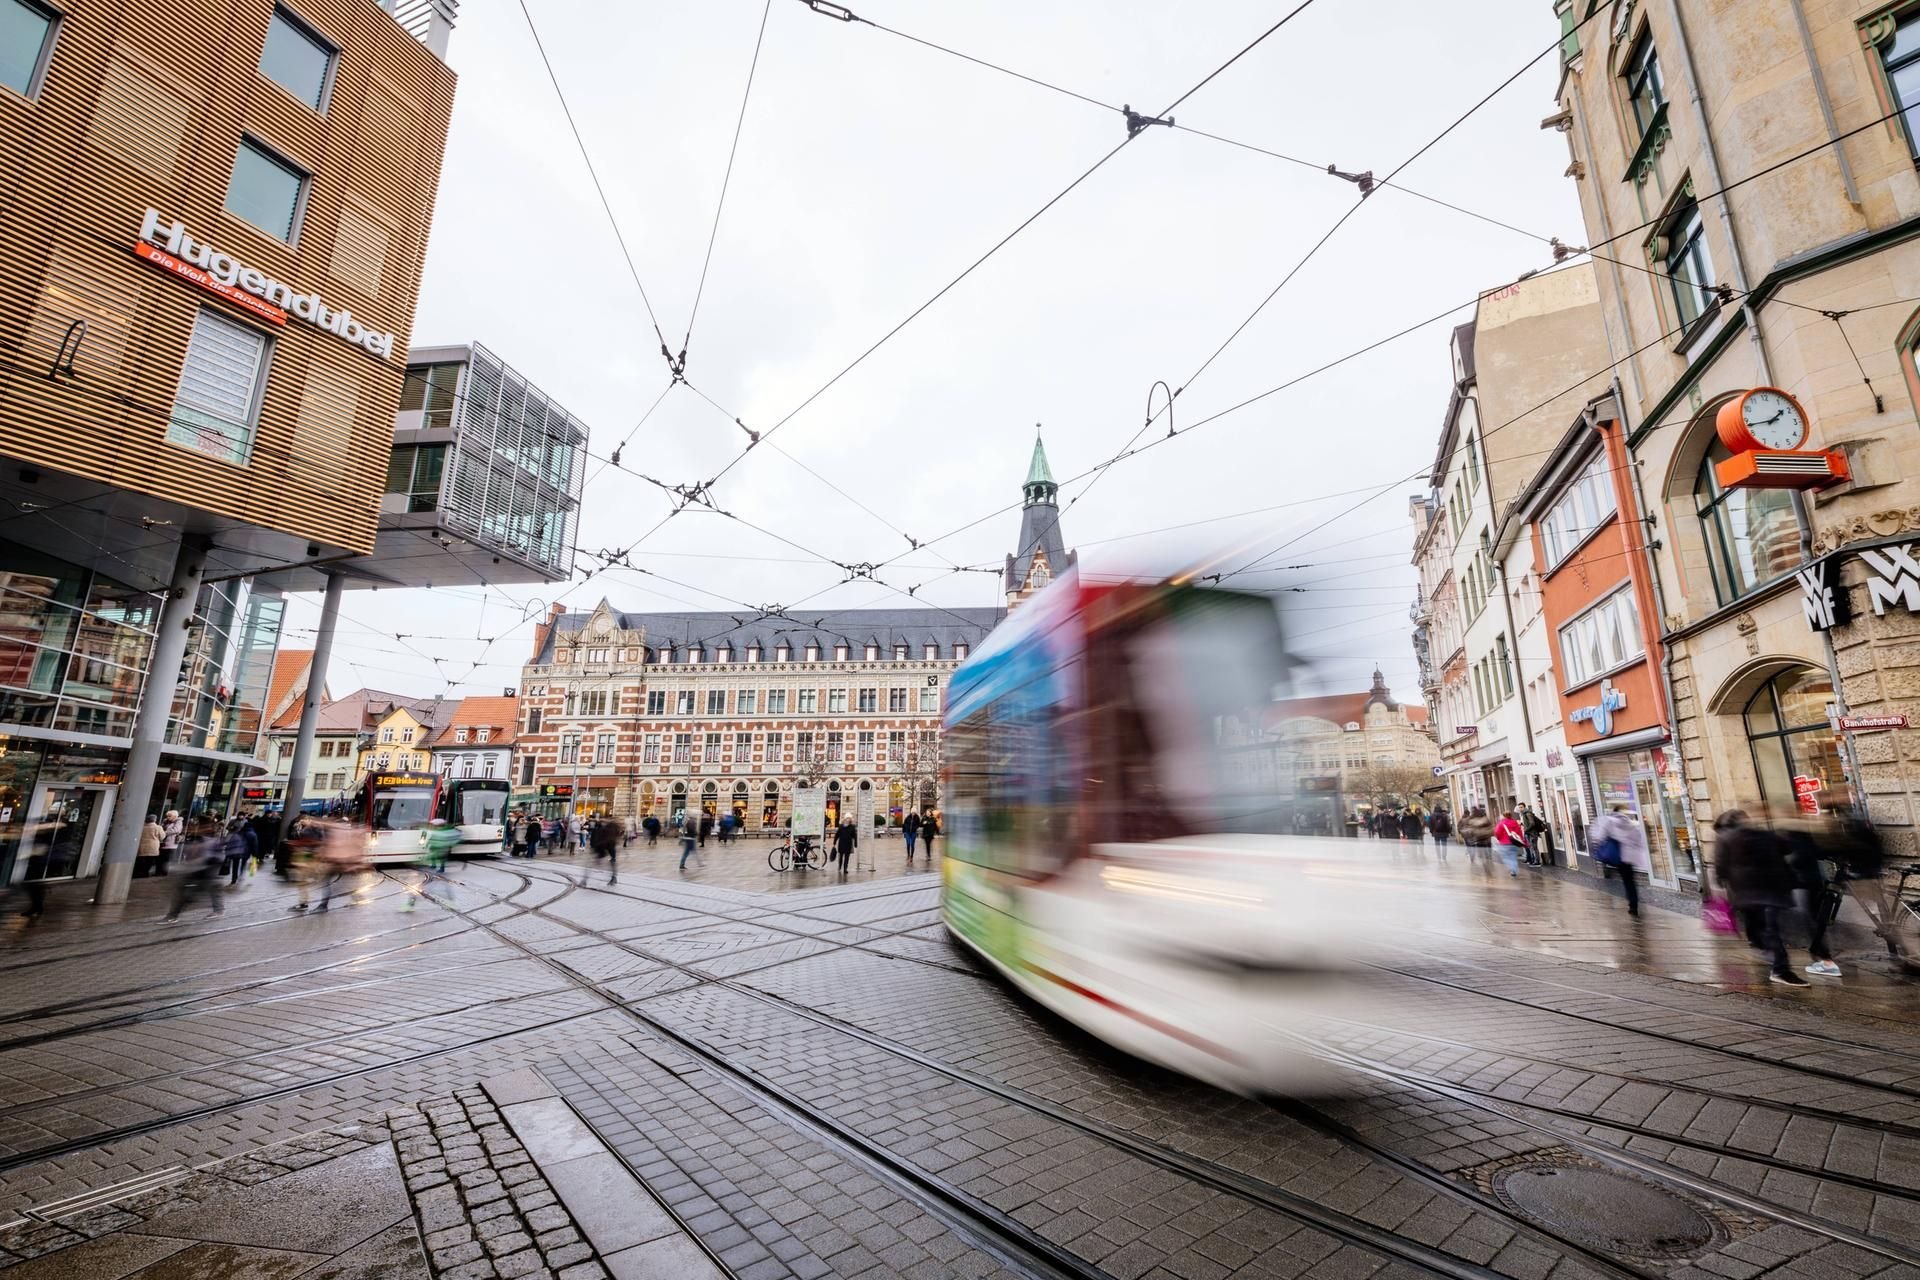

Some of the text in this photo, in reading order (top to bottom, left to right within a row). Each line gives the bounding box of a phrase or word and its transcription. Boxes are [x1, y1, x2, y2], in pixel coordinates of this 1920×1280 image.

[139, 206, 394, 359] Hugendubel
[148, 251, 174, 268] Die
[176, 263, 207, 284] Welt
[209, 280, 233, 295] der
[1796, 561, 1835, 632] WMF
[1843, 716, 1903, 728] Bahnhofstraße
[377, 776, 383, 785] 3
